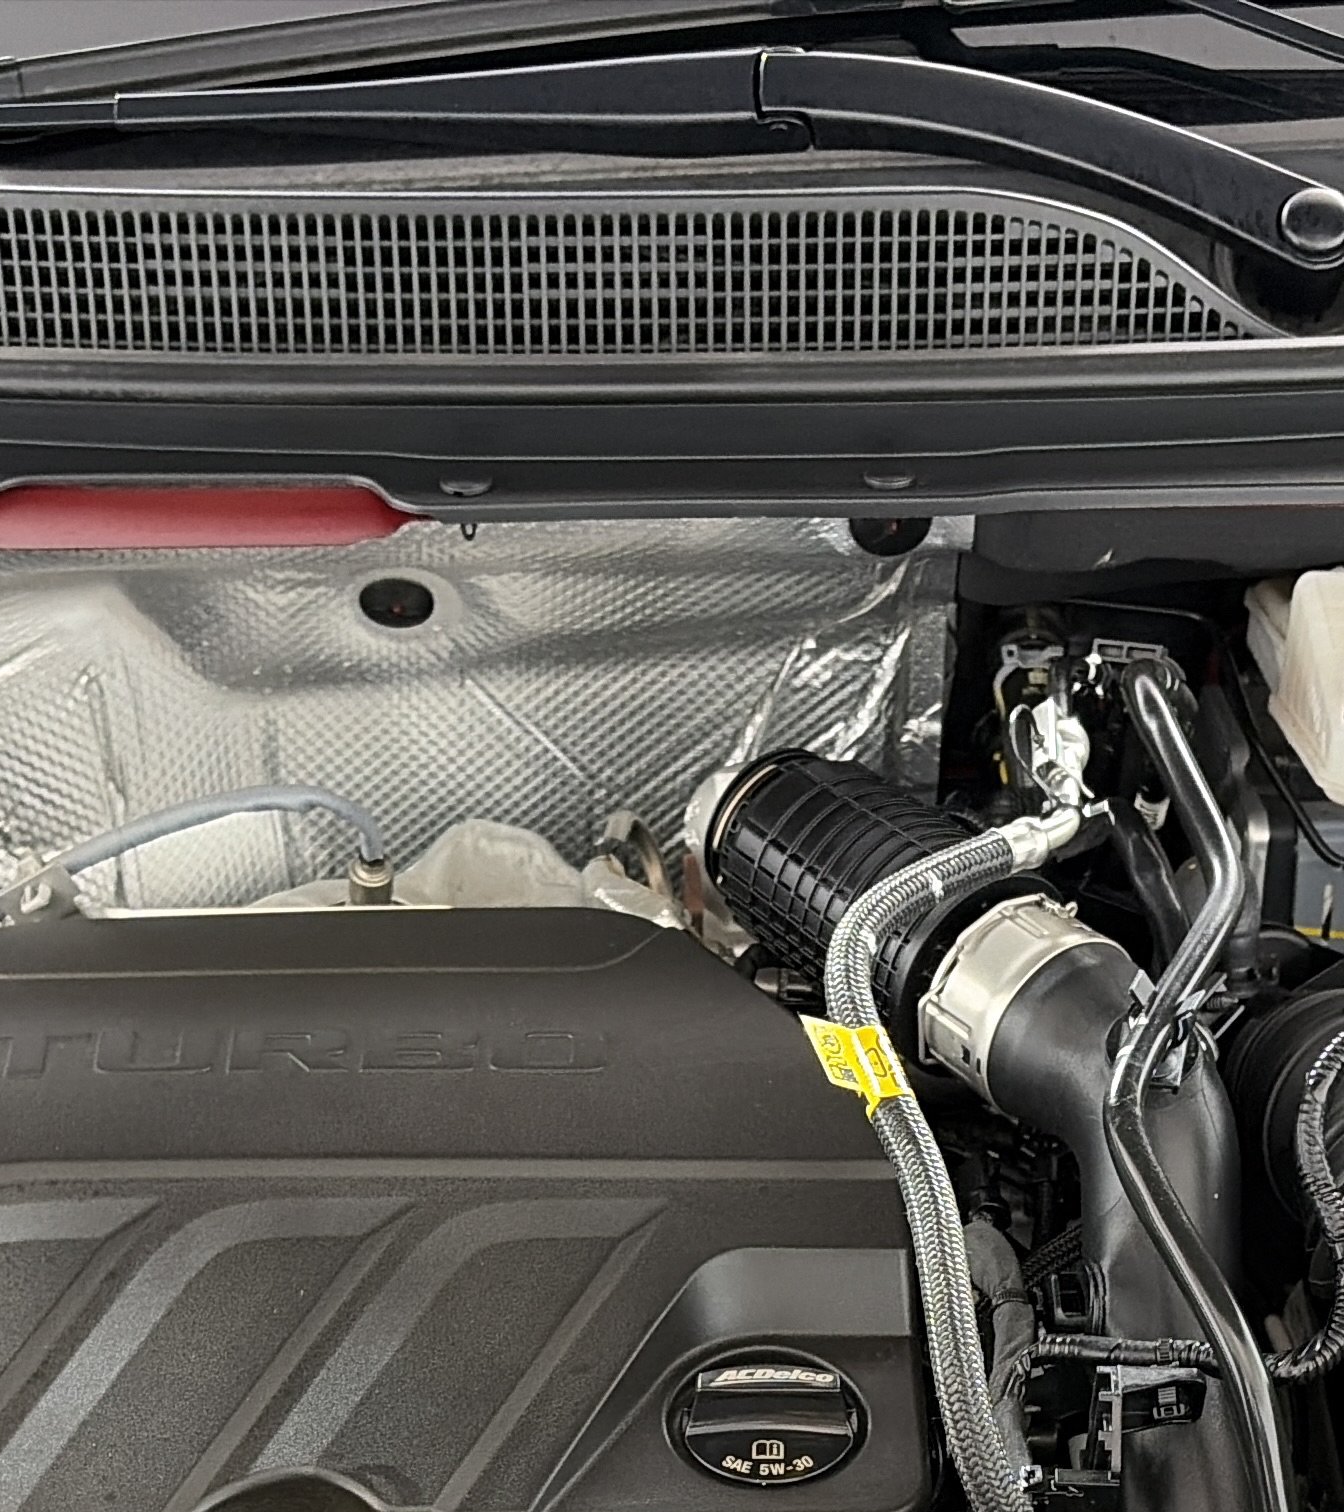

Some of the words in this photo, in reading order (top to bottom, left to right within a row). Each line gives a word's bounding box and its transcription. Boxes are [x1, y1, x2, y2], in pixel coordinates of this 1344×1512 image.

[714, 1368, 834, 1383] ACDelco
[721, 1454, 753, 1475] SAE
[758, 1454, 815, 1477] 5W-30
